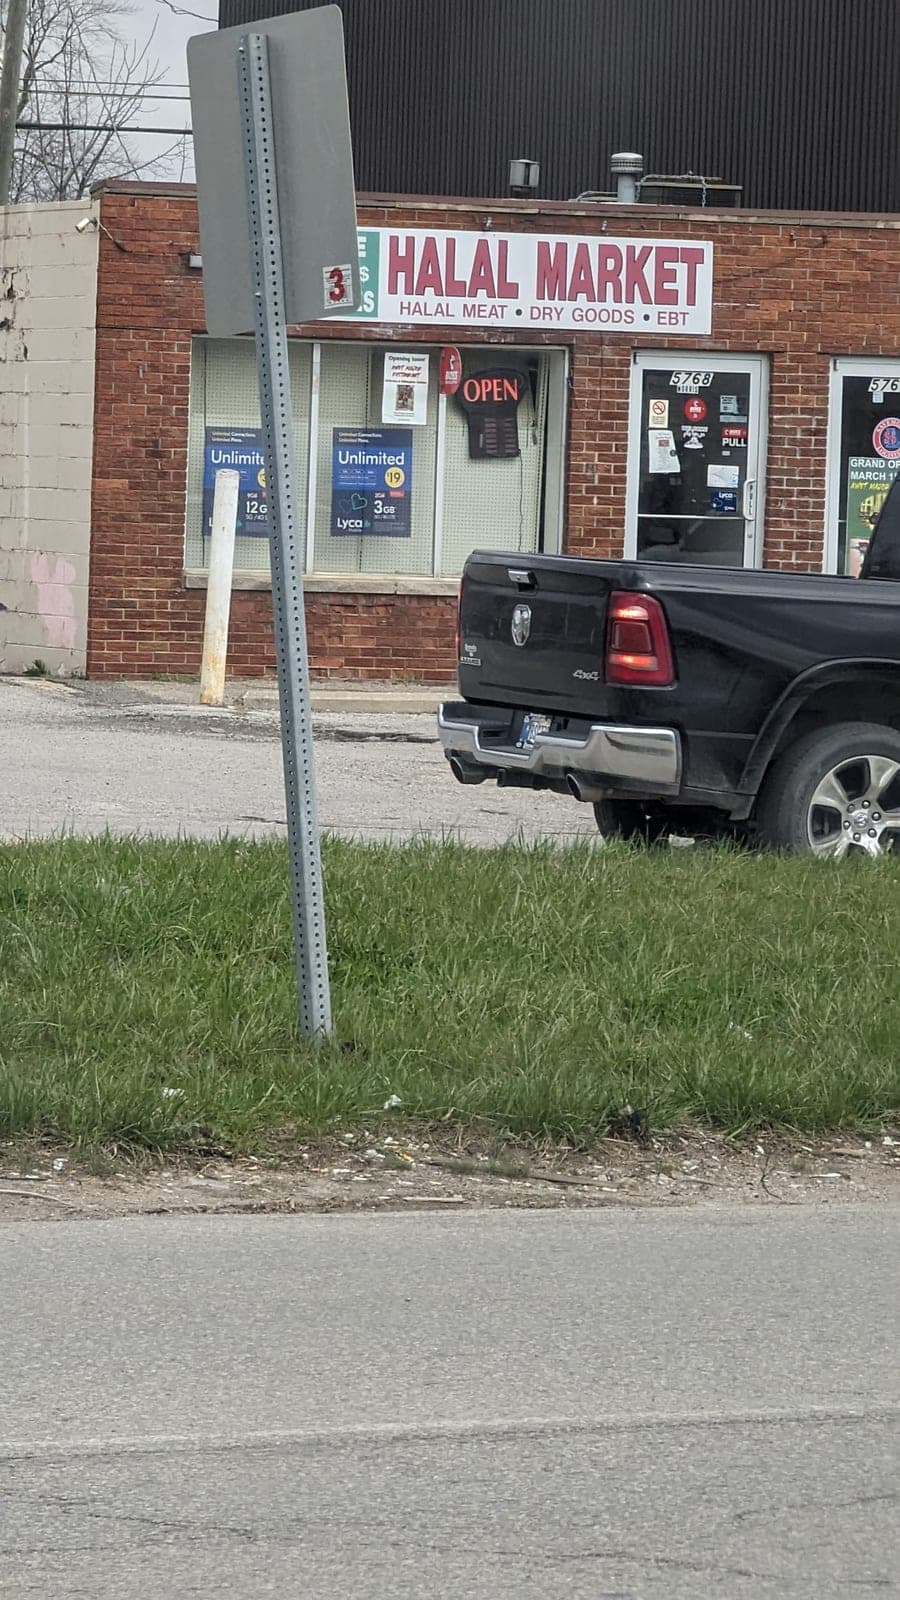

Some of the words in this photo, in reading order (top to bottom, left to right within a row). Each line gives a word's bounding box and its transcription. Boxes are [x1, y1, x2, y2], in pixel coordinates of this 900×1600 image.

[388, 235, 519, 299] HALAL
[536, 241, 704, 306] MARKET
[400, 302, 454, 318] HALAL
[463, 304, 508, 320] MEAT
[530, 306, 564, 321] DRY
[572, 308, 635, 324] GOODS
[657, 312, 690, 326] EBT
[672, 372, 711, 385] 5768
[463, 378, 518, 402] OPEN
[722, 438, 747, 447] PULL
[212, 450, 264, 465] Unlimit
[338, 450, 404, 465] Unlimited
[850, 458, 885, 468] GRAND
[850, 472, 886, 480] MARCH
[246, 500, 268, 514] 12G
[337, 518, 362, 530] Lyca
